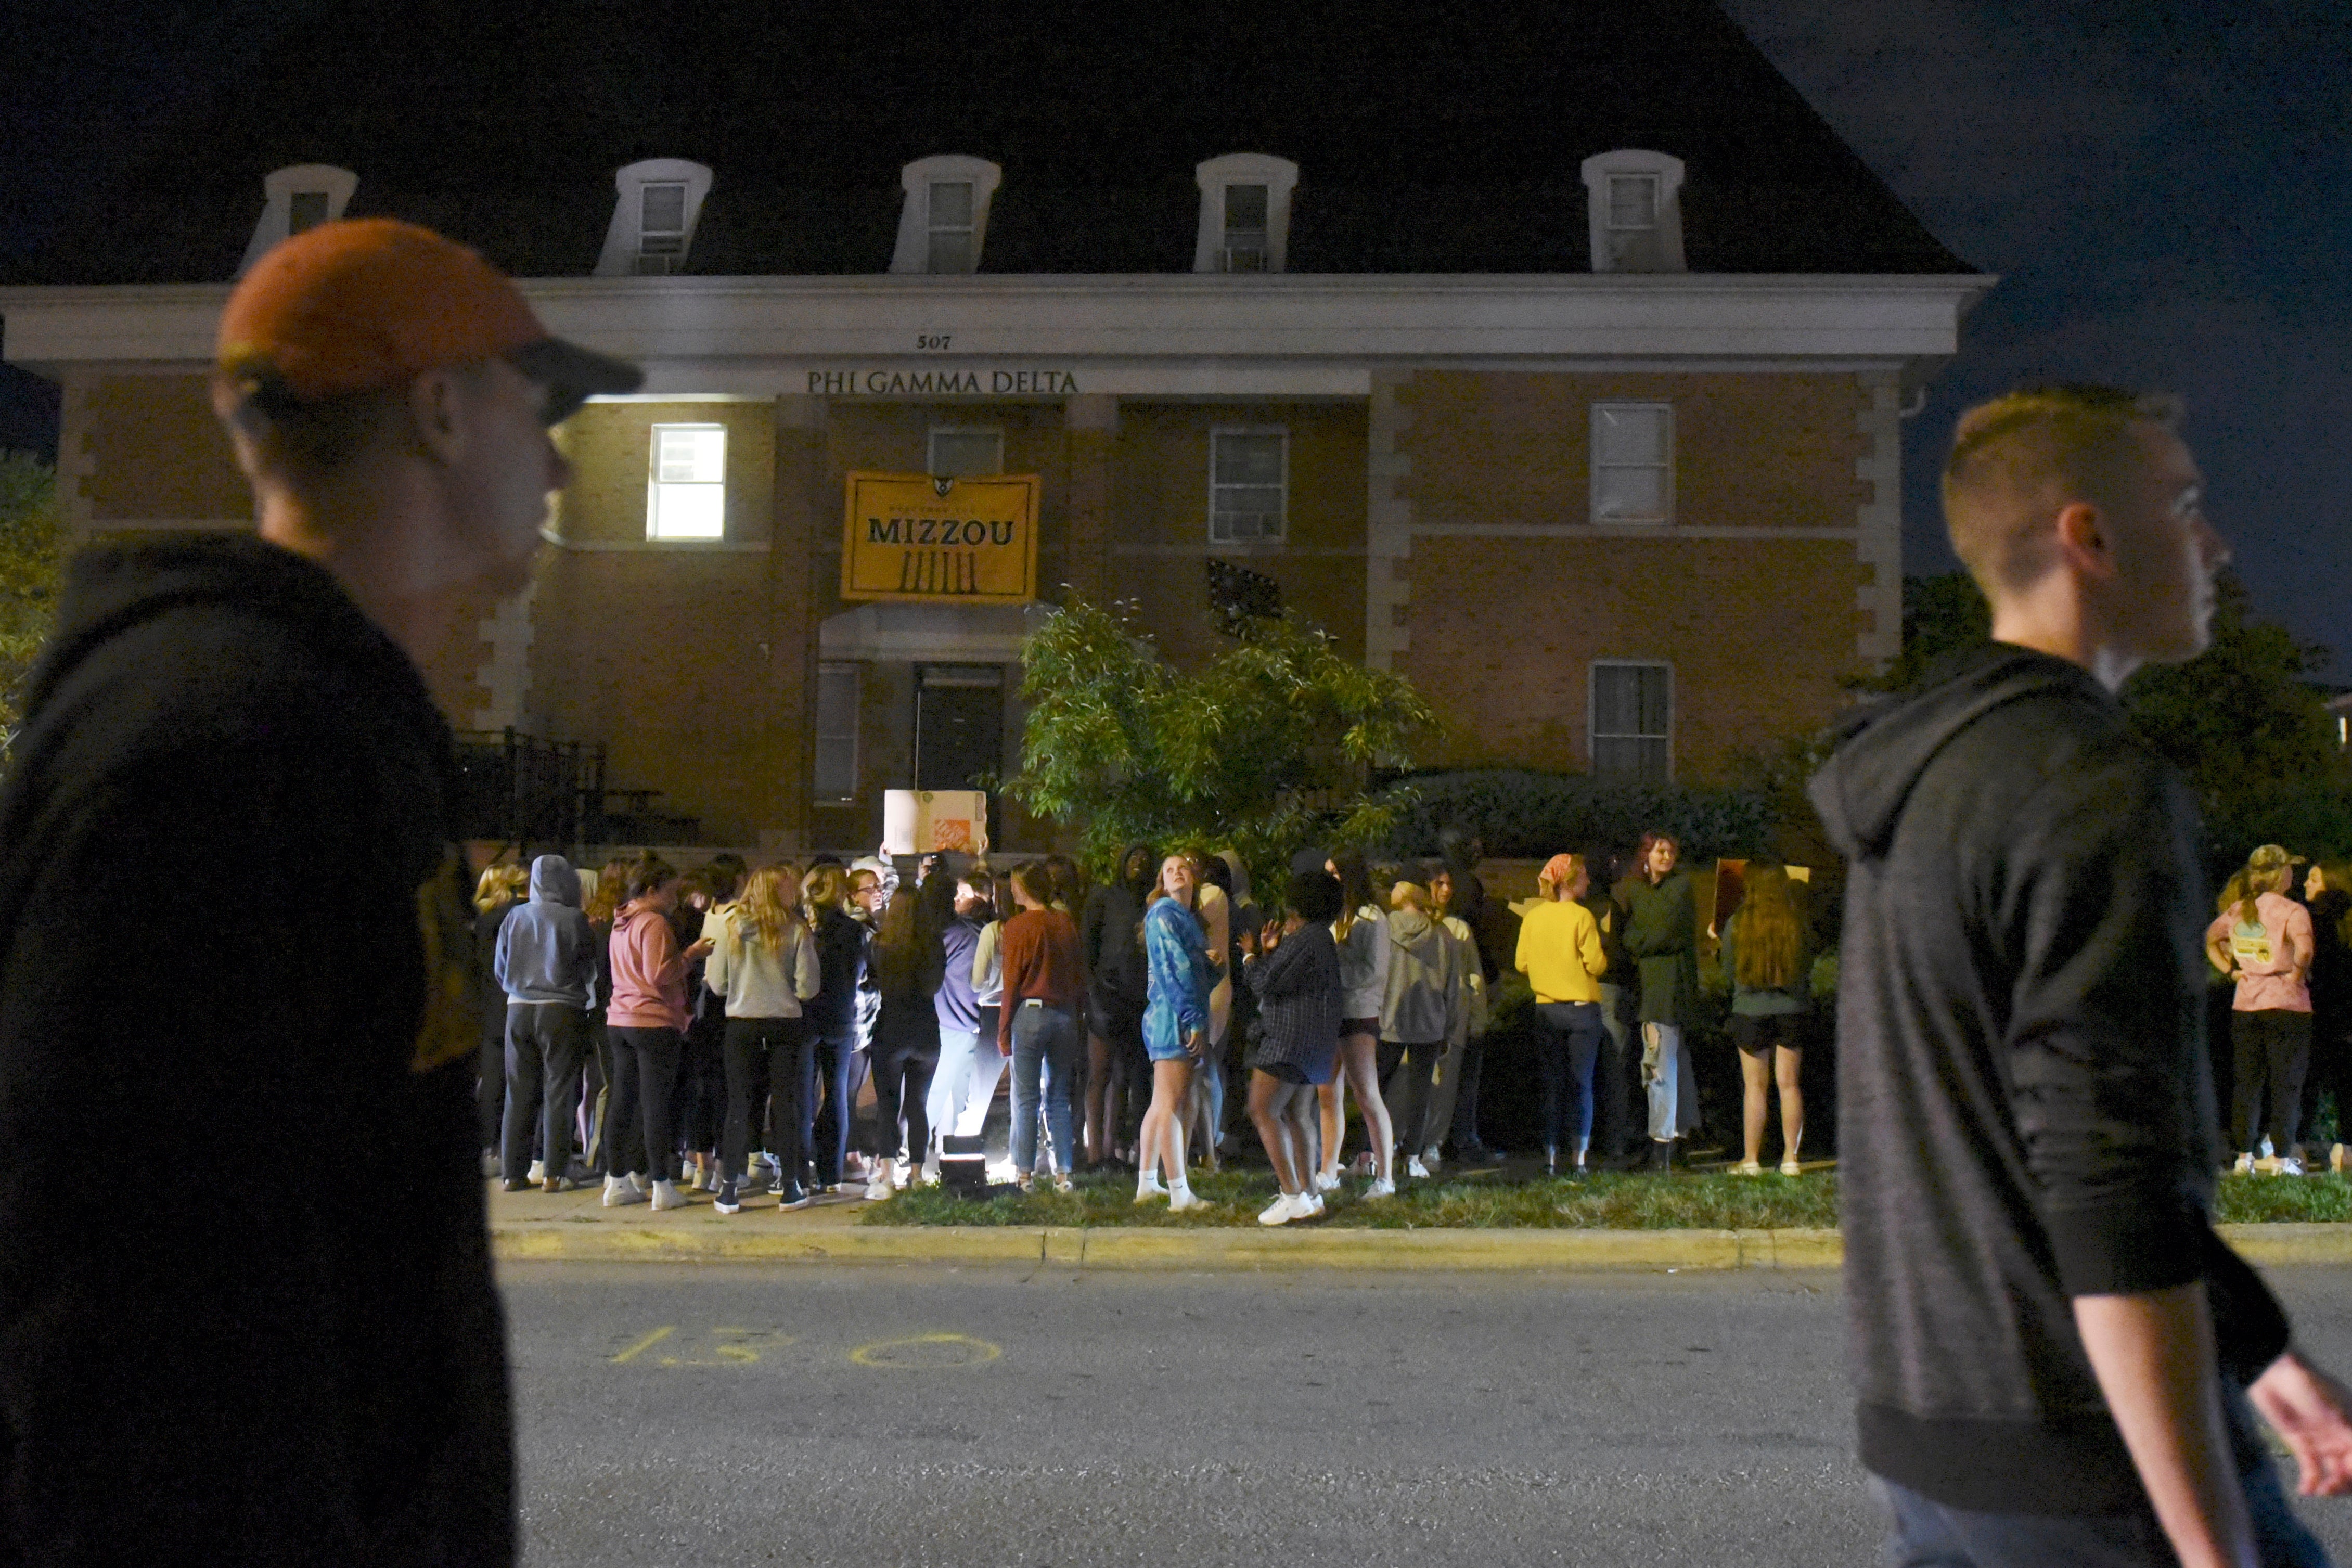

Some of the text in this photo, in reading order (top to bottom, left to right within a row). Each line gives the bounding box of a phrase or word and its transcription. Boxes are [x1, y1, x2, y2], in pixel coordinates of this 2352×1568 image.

[917, 335, 951, 350] 507
[807, 371, 1079, 393] PHI GAMMA DELTA
[867, 518, 1014, 546] MIZZOU
